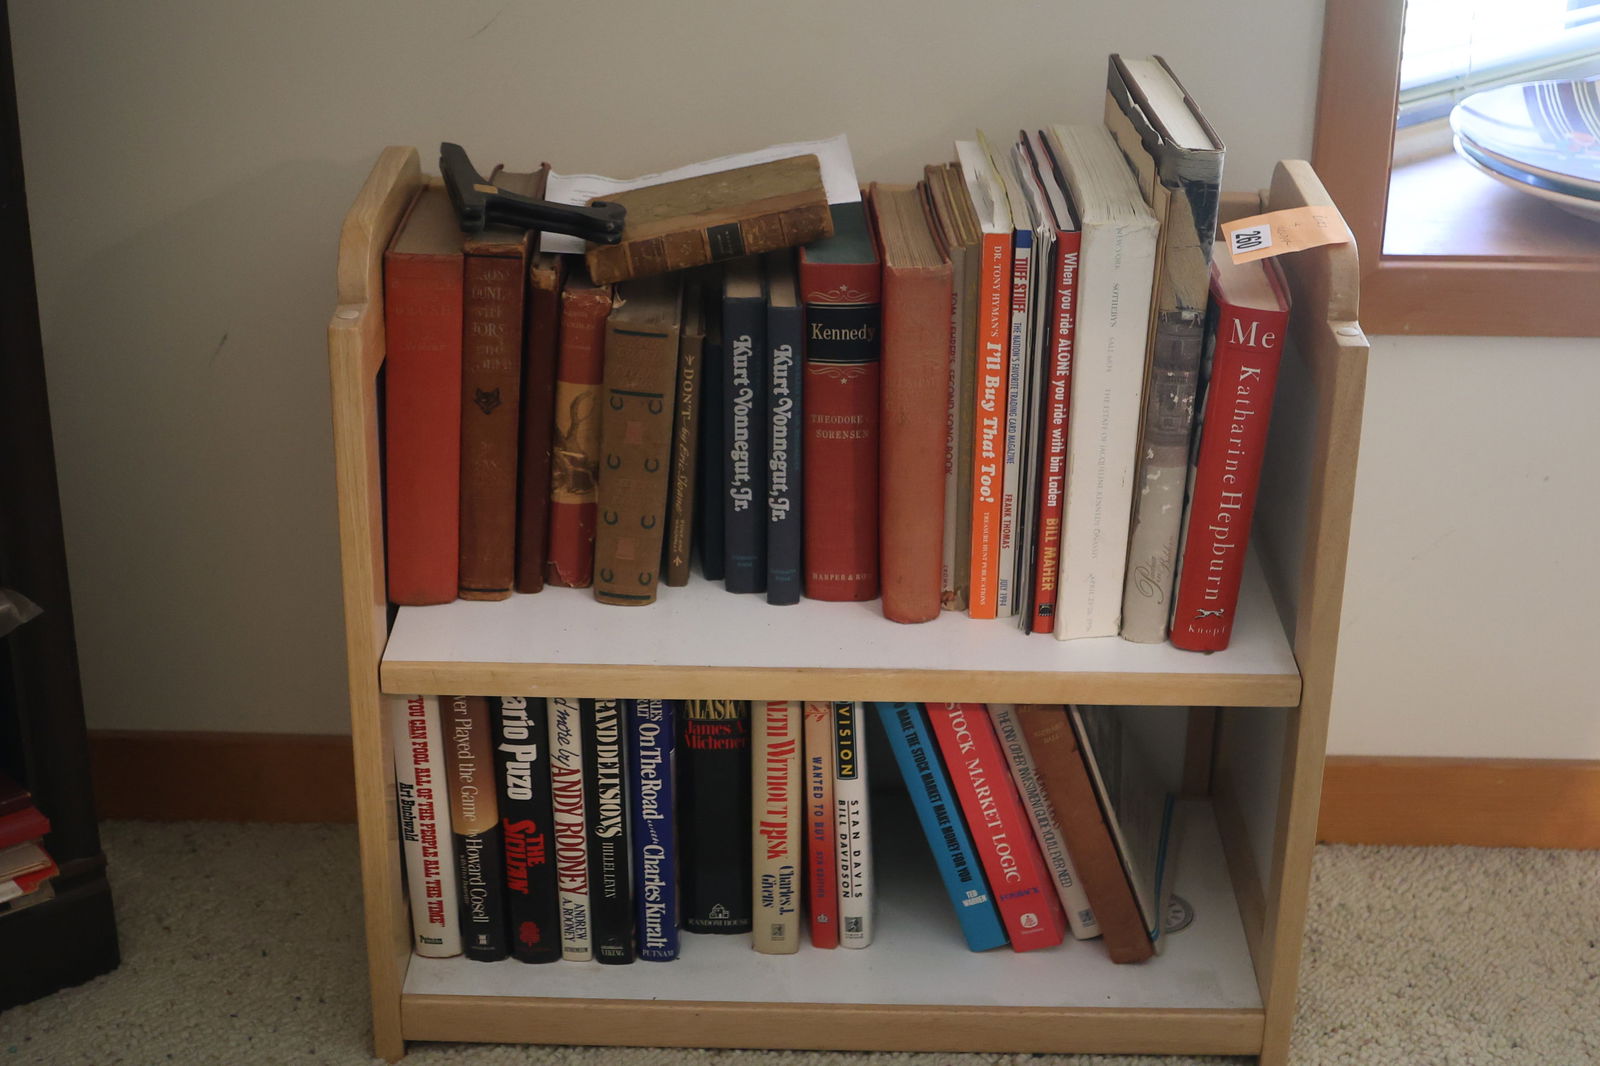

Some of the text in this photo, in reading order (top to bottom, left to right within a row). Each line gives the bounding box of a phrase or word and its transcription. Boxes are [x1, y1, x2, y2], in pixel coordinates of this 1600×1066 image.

[1235, 230, 1262, 249] 260
[1013, 257, 1028, 280] TUFF
[1012, 283, 1027, 313] STUFF
[811, 323, 876, 342] Kennedy
[1013, 322, 1022, 334] THE
[1228, 318, 1276, 348] Me
[1011, 335, 1021, 362] NATION'S
[980, 245, 1003, 503] DR. TONY HYMAN'S I'll Buy That Too!
[1010, 363, 1020, 390] FAVORITE
[681, 368, 695, 418] DON'T
[1009, 391, 1018, 417] TRADING
[678, 426, 691, 441] by
[730, 335, 753, 512] Kurt Vonnegut, Jr.
[768, 344, 793, 522] Kurt Vonnegut, Jr.
[810, 414, 864, 425] THEODORE
[815, 429, 869, 440] SORENSEN
[945, 413, 954, 443] SONG
[1008, 418, 1017, 434] CARD
[1041, 252, 1078, 591] When you ride ALONE you ride with bin Laden BILL MAHER
[677, 443, 690, 470] Eric
[943, 446, 953, 476] BOOK
[1006, 435, 1016, 464] MAGAZINE
[675, 473, 688, 514] Sloane
[1204, 365, 1261, 600] Katharine Hepburn
[1002, 494, 1013, 517] FRANK
[1002, 519, 1011, 549] THOMAS
[979, 512, 990, 605] TREASURE HUNT PUBLICATIONS
[999, 578, 1008, 591] JULY
[409, 719, 427, 739] CAN
[556, 709, 572, 745] more
[996, 711, 1011, 723] THE
[453, 718, 476, 759] Played
[497, 697, 537, 800] ario Puzo
[639, 722, 661, 747] On
[838, 706, 853, 775] VISION
[1001, 725, 1017, 745] ONLY
[412, 741, 430, 765] FOOL
[551, 749, 580, 767] by
[640, 747, 663, 779] The
[1008, 744, 1027, 766] OTHER
[415, 768, 431, 786] ALL
[458, 763, 477, 783] the
[812, 757, 823, 799] WANTED
[1017, 767, 1040, 809] INVESTMENT
[416, 788, 433, 800] OF
[460, 785, 479, 822] Game
[551, 764, 584, 817] ANDY
[593, 698, 622, 898] RAND DELUSIONS HILLEL LEVIN
[641, 779, 665, 820] Road
[896, 709, 973, 883] MAKE THE STOCK MARKET MAKE MONEY FOR YOU
[945, 702, 976, 754] STOCK
[965, 758, 1003, 829] MARKET
[991, 833, 1021, 883] LOGIC
[399, 782, 419, 842] Art Buchwald
[418, 801, 435, 821] THE
[813, 804, 824, 817] TO
[1034, 809, 1051, 829] GUIDE
[419, 823, 438, 857] PEOPLE
[814, 822, 825, 841] BUY
[464, 838, 487, 885] Howard
[502, 817, 536, 894] SICILIAN
[527, 833, 545, 867] THE
[555, 820, 588, 896] ROONEY
[838, 800, 850, 898] BILL DAVIDSON
[850, 800, 863, 898] STAN DAVIS
[1049, 851, 1065, 869] EVER
[424, 859, 440, 877] ALL
[643, 844, 667, 901] Charles
[1056, 869, 1073, 888] NEED
[425, 879, 443, 898] THE
[563, 897, 572, 906] A.
[761, 874, 777, 908] Givens
[778, 865, 795, 916] Charles J.
[470, 888, 490, 923] Cosell
[563, 908, 576, 942] ROONEY
[573, 903, 588, 940] ANDREW
[645, 902, 668, 949] Kuralt
[642, 949, 674, 957] PUTNAM
